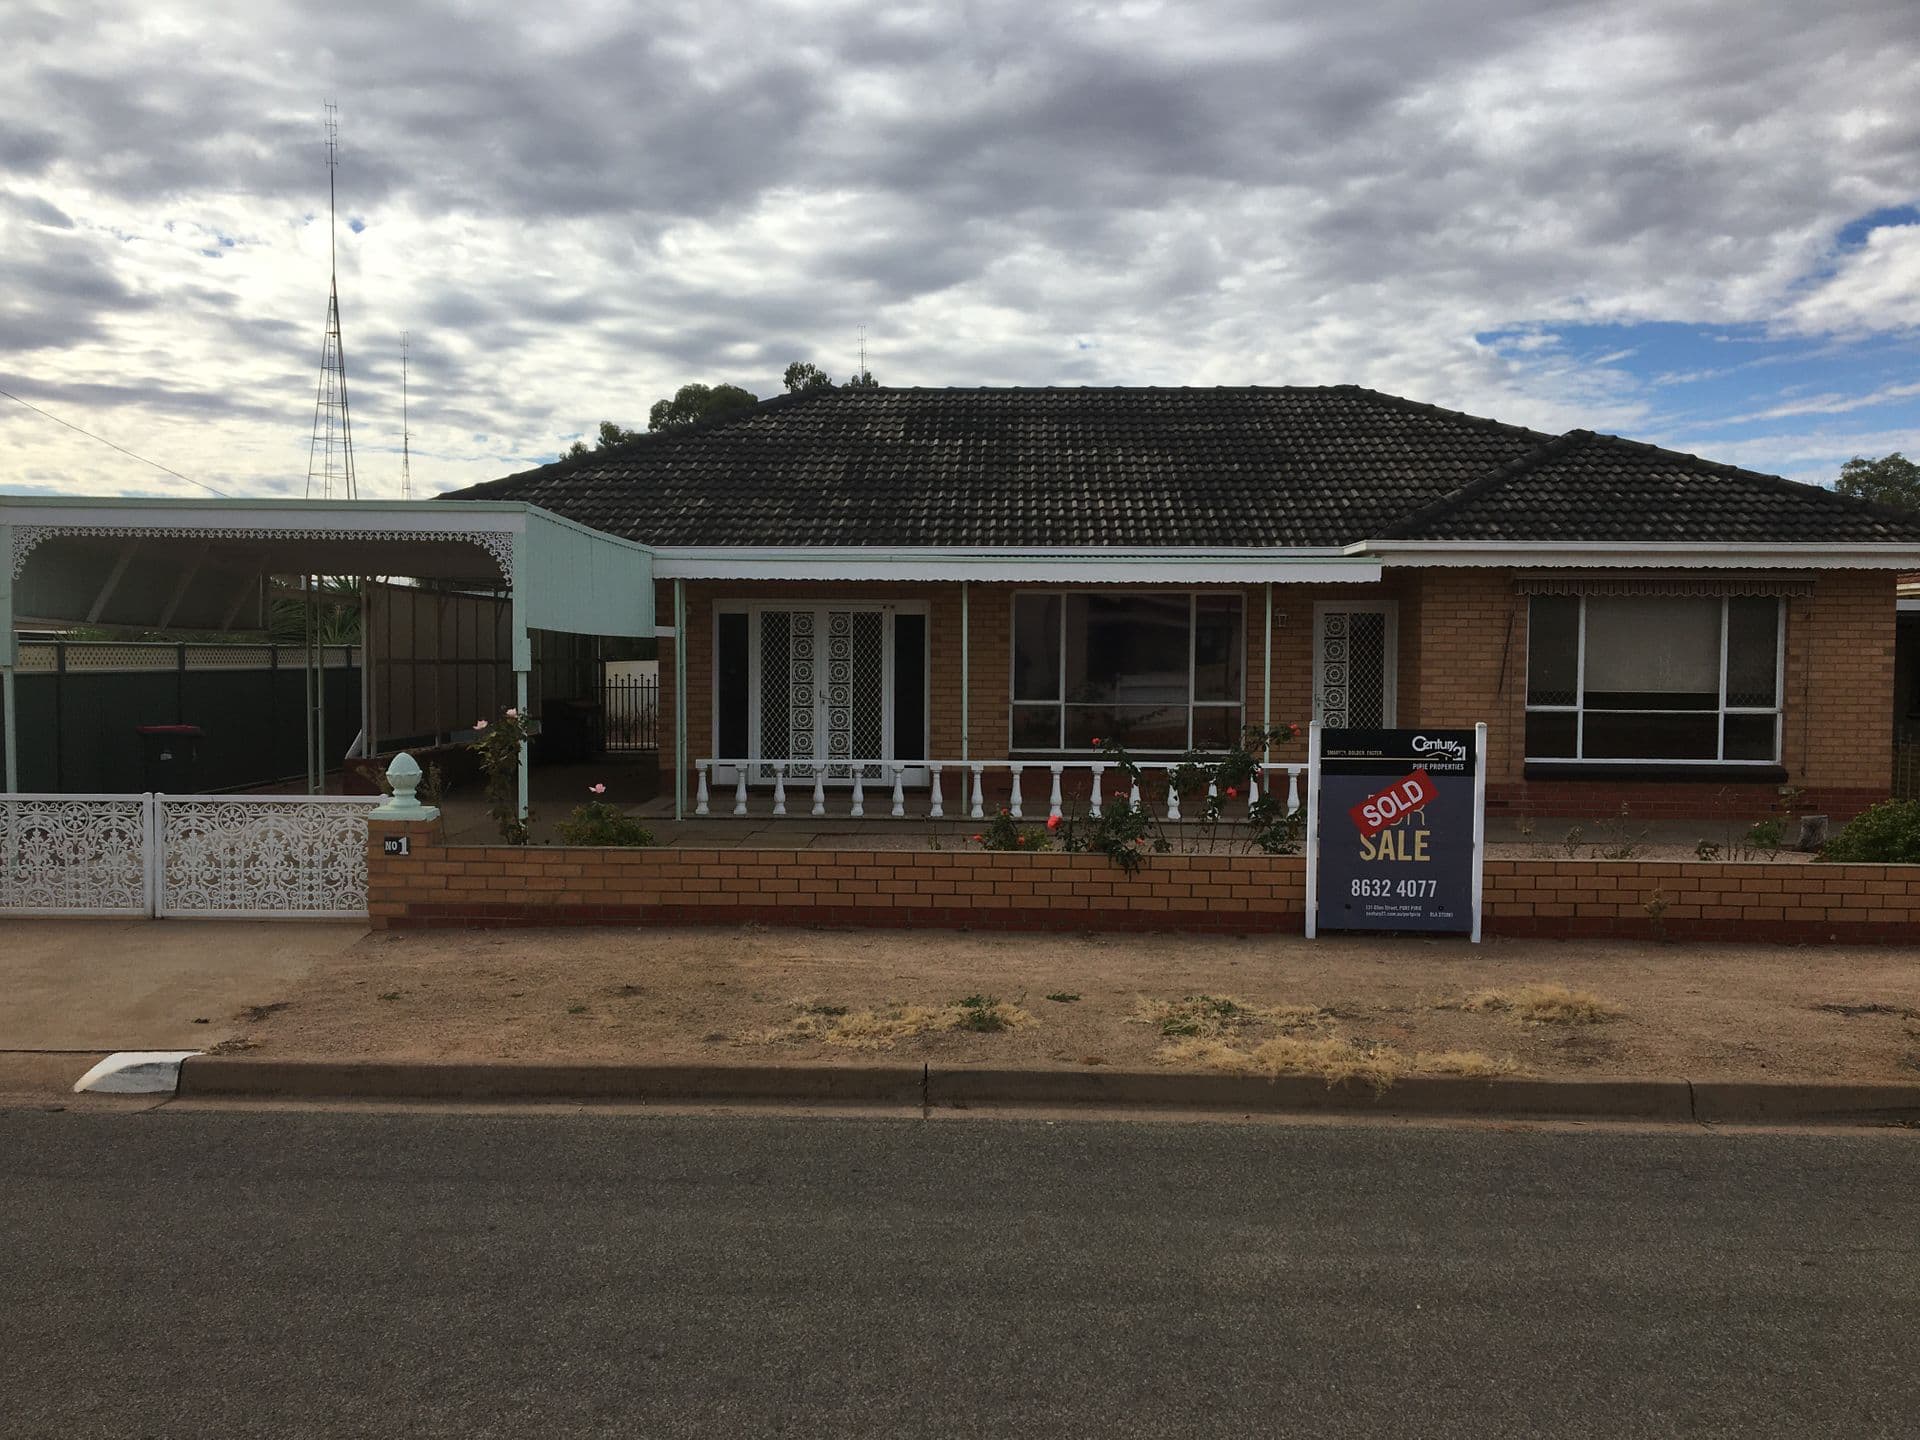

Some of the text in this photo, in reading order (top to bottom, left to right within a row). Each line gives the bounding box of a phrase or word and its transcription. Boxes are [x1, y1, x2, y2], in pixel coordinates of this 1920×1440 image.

[1412, 735, 1466, 761] Century 21
[1363, 780, 1424, 827] SOLD
[398, 837, 409, 855] 1
[1359, 829, 1431, 861] SALE
[1351, 879, 1437, 898] 8632 4077
